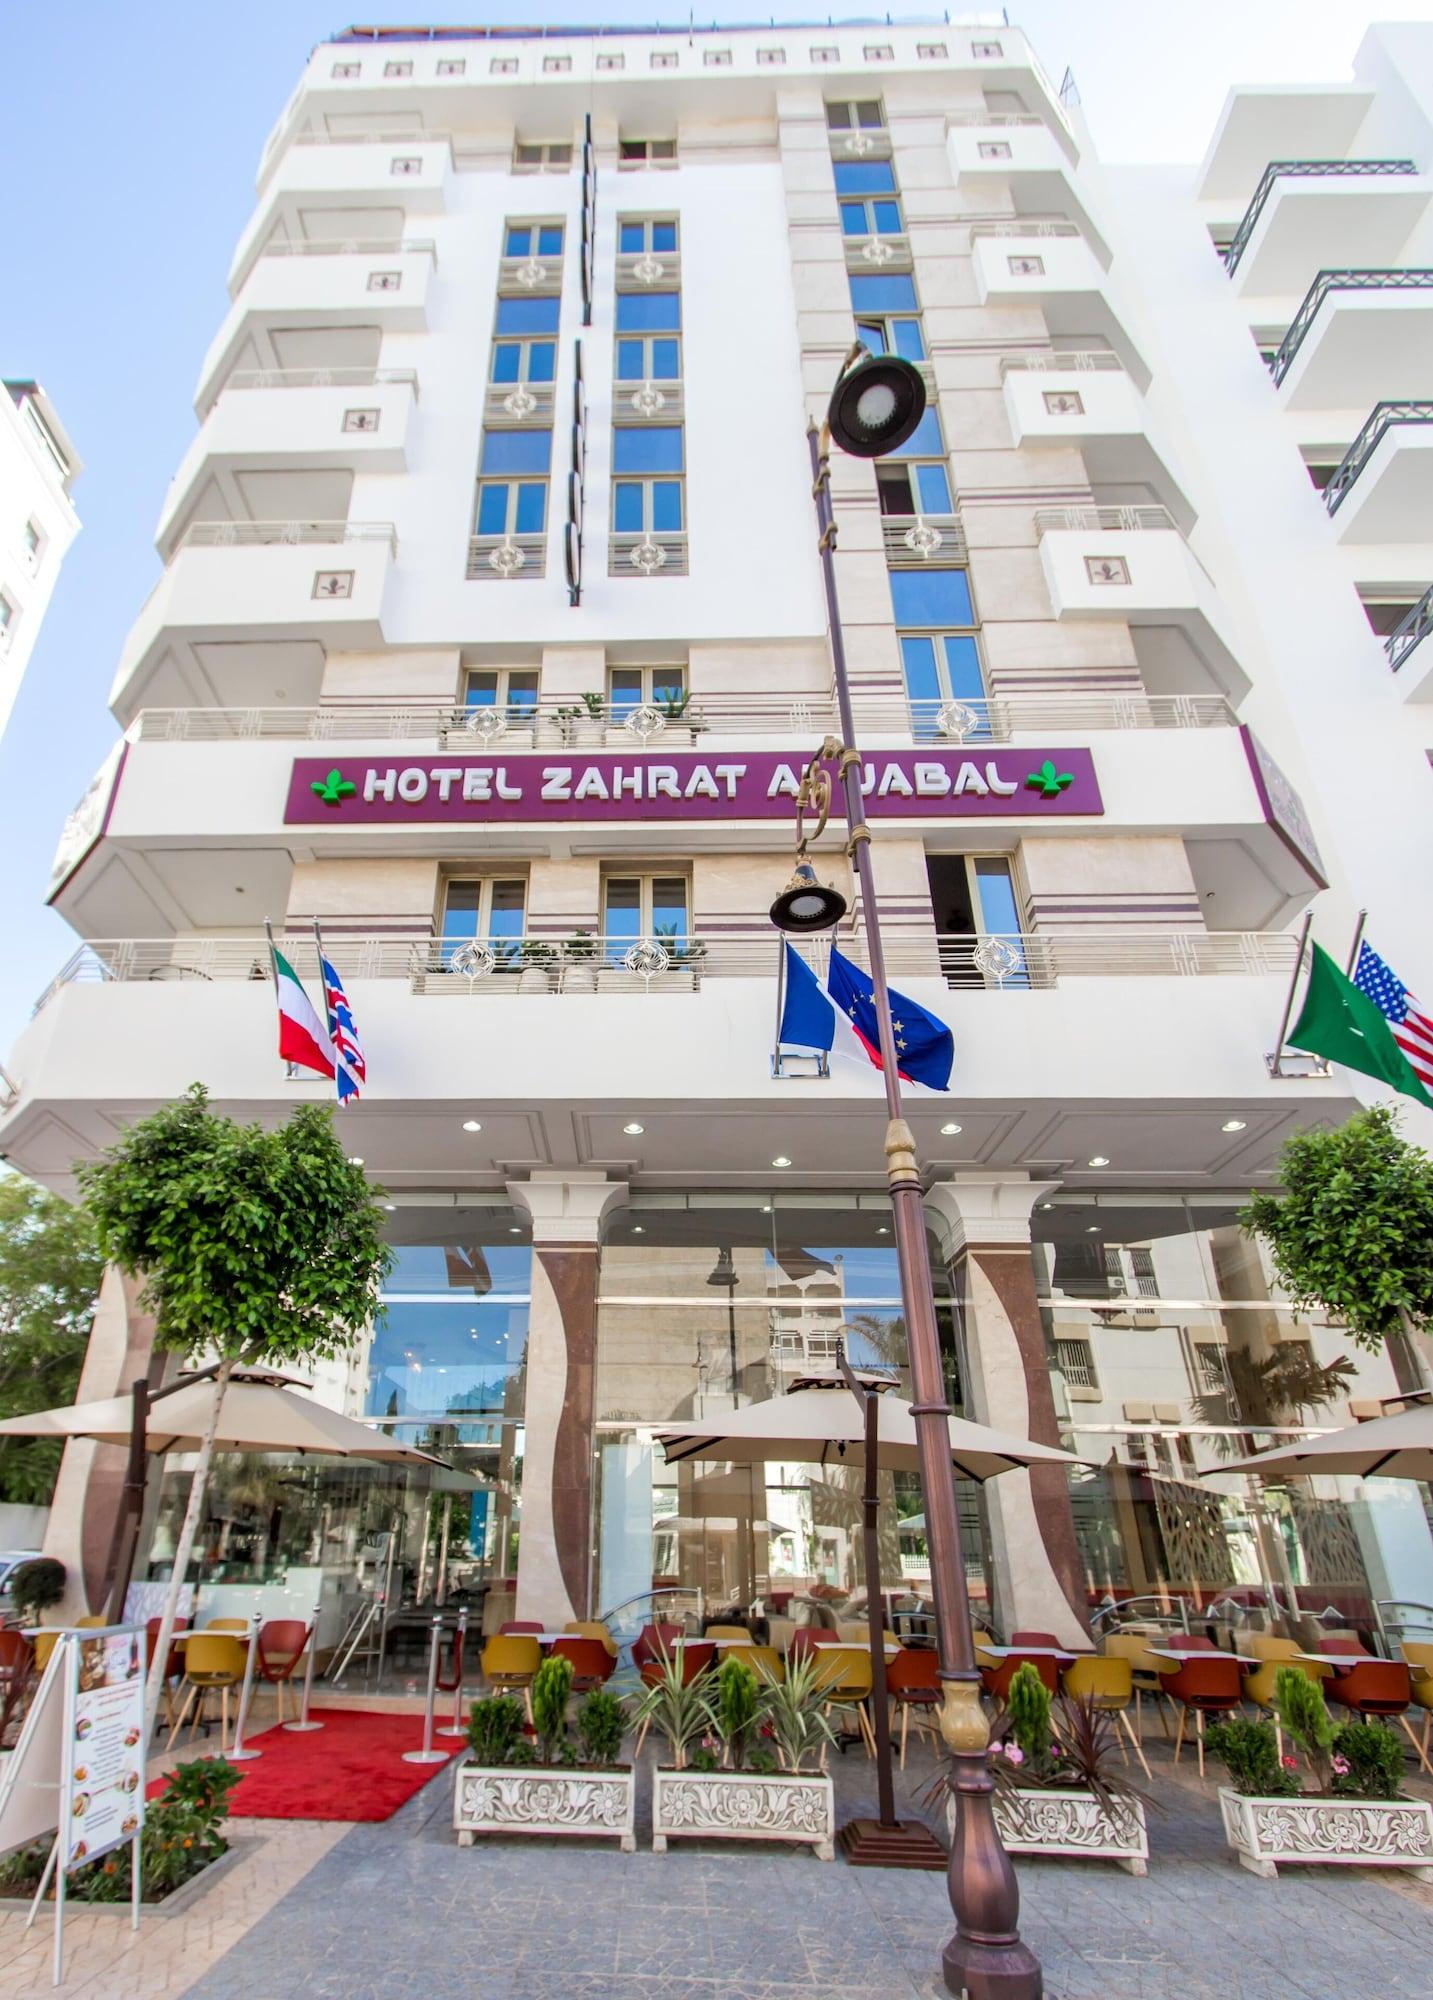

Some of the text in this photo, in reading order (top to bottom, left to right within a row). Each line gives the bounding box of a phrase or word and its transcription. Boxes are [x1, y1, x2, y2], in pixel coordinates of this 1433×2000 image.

[363, 762, 1018, 802] HOTEL ZAHRAT A JABAL
